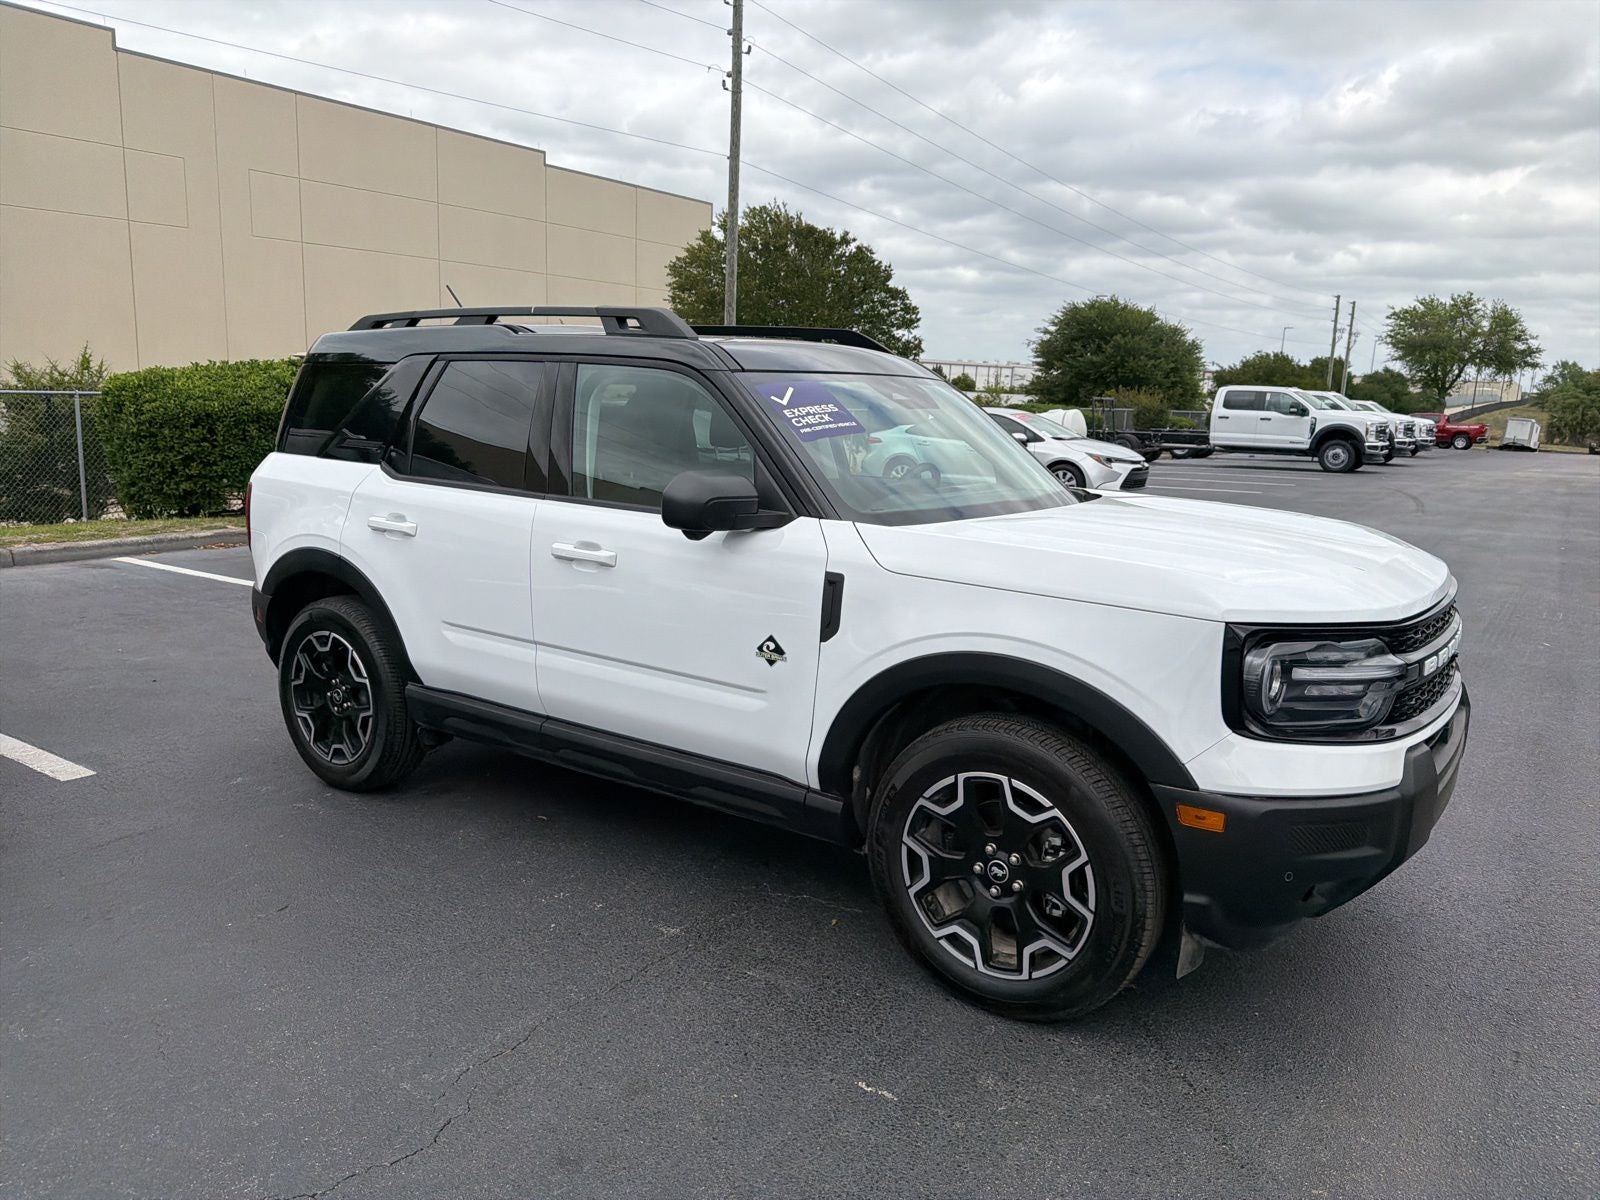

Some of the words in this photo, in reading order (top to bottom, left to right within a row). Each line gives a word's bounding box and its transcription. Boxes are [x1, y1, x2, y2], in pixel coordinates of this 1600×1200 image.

[783, 404, 839, 418] EXPRESS
[792, 414, 834, 426] CHECK
[1424, 623, 1462, 676] BRO
